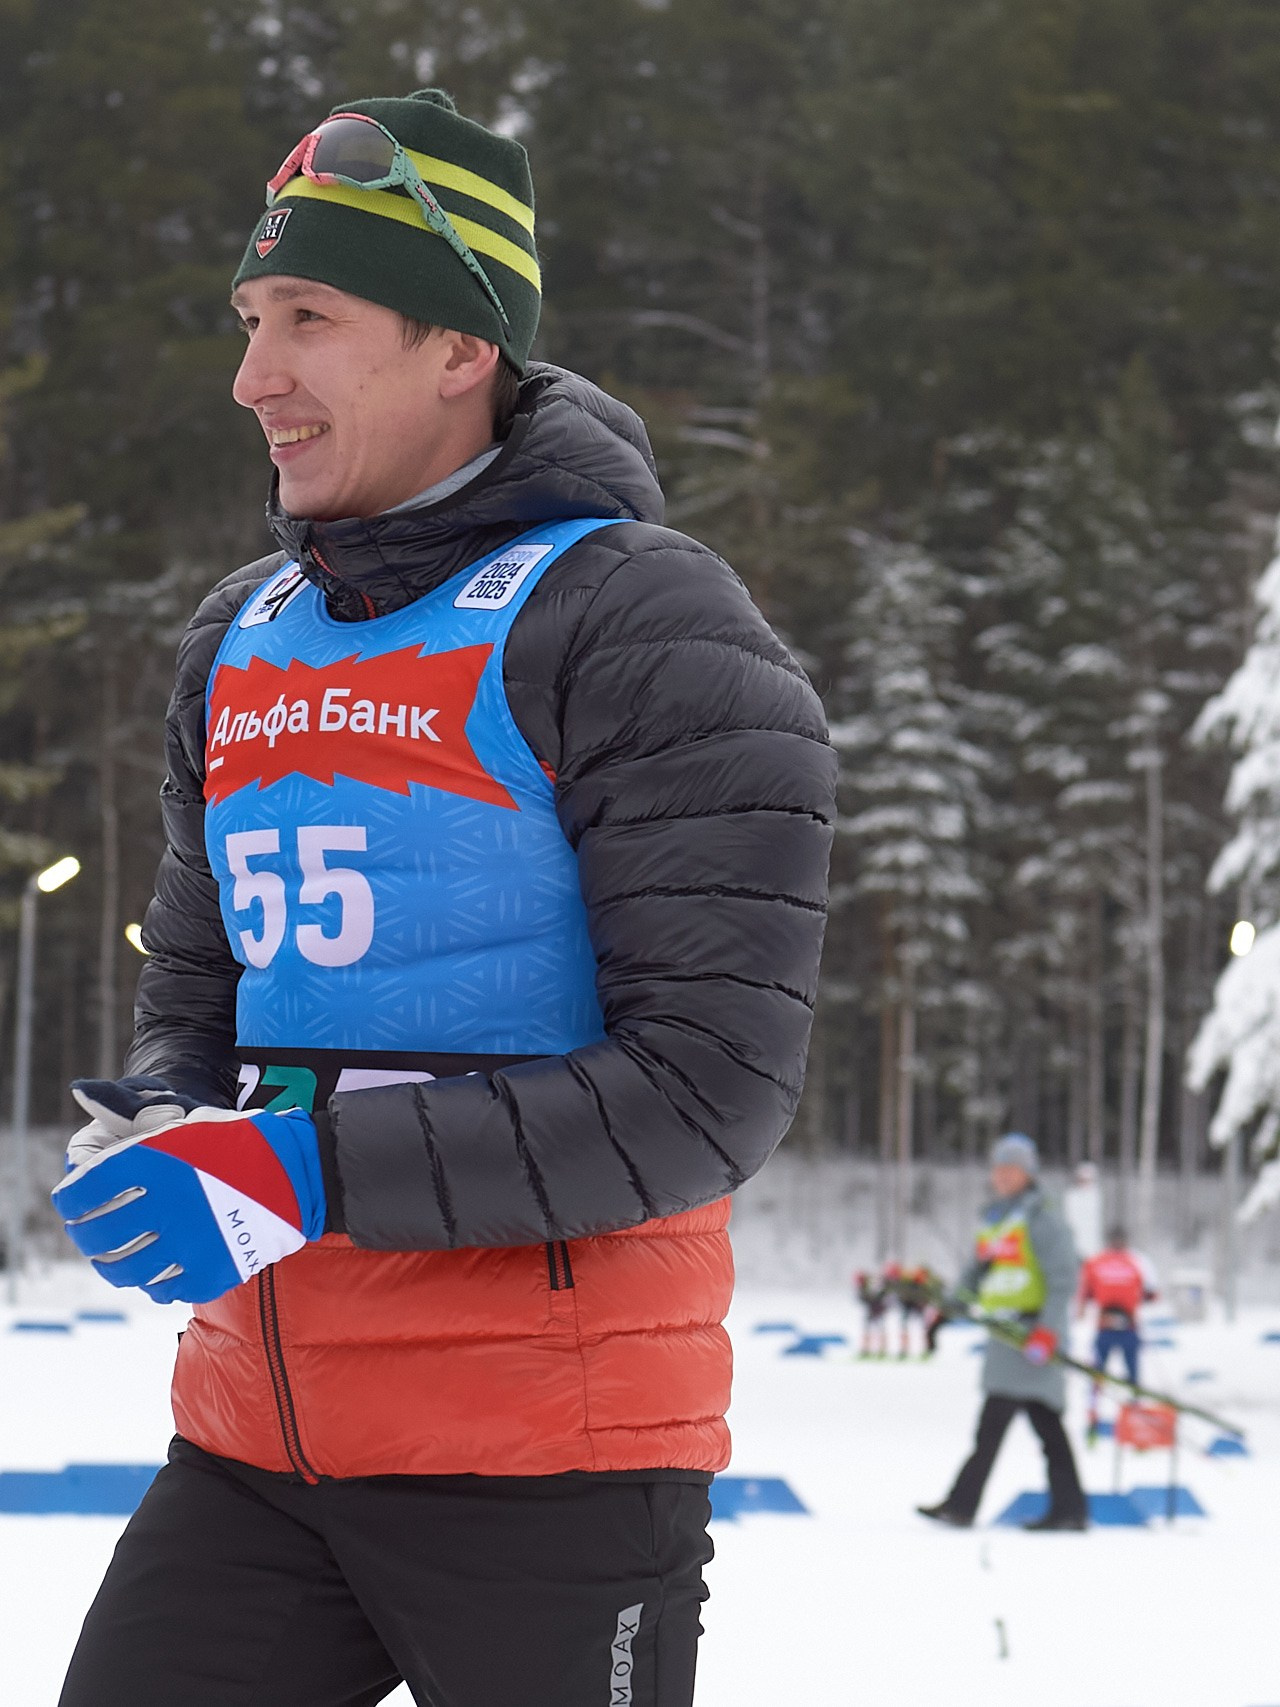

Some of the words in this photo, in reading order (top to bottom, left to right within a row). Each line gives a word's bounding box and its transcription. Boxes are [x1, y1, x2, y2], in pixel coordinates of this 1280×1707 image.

[466, 580, 511, 599] 2025
[481, 562, 525, 579] 2024
[210, 693, 310, 753] Альфа
[319, 688, 442, 743] Банк
[225, 825, 375, 969] 55
[227, 1208, 259, 1273] MOAX
[612, 1621, 638, 1706] MOAX
